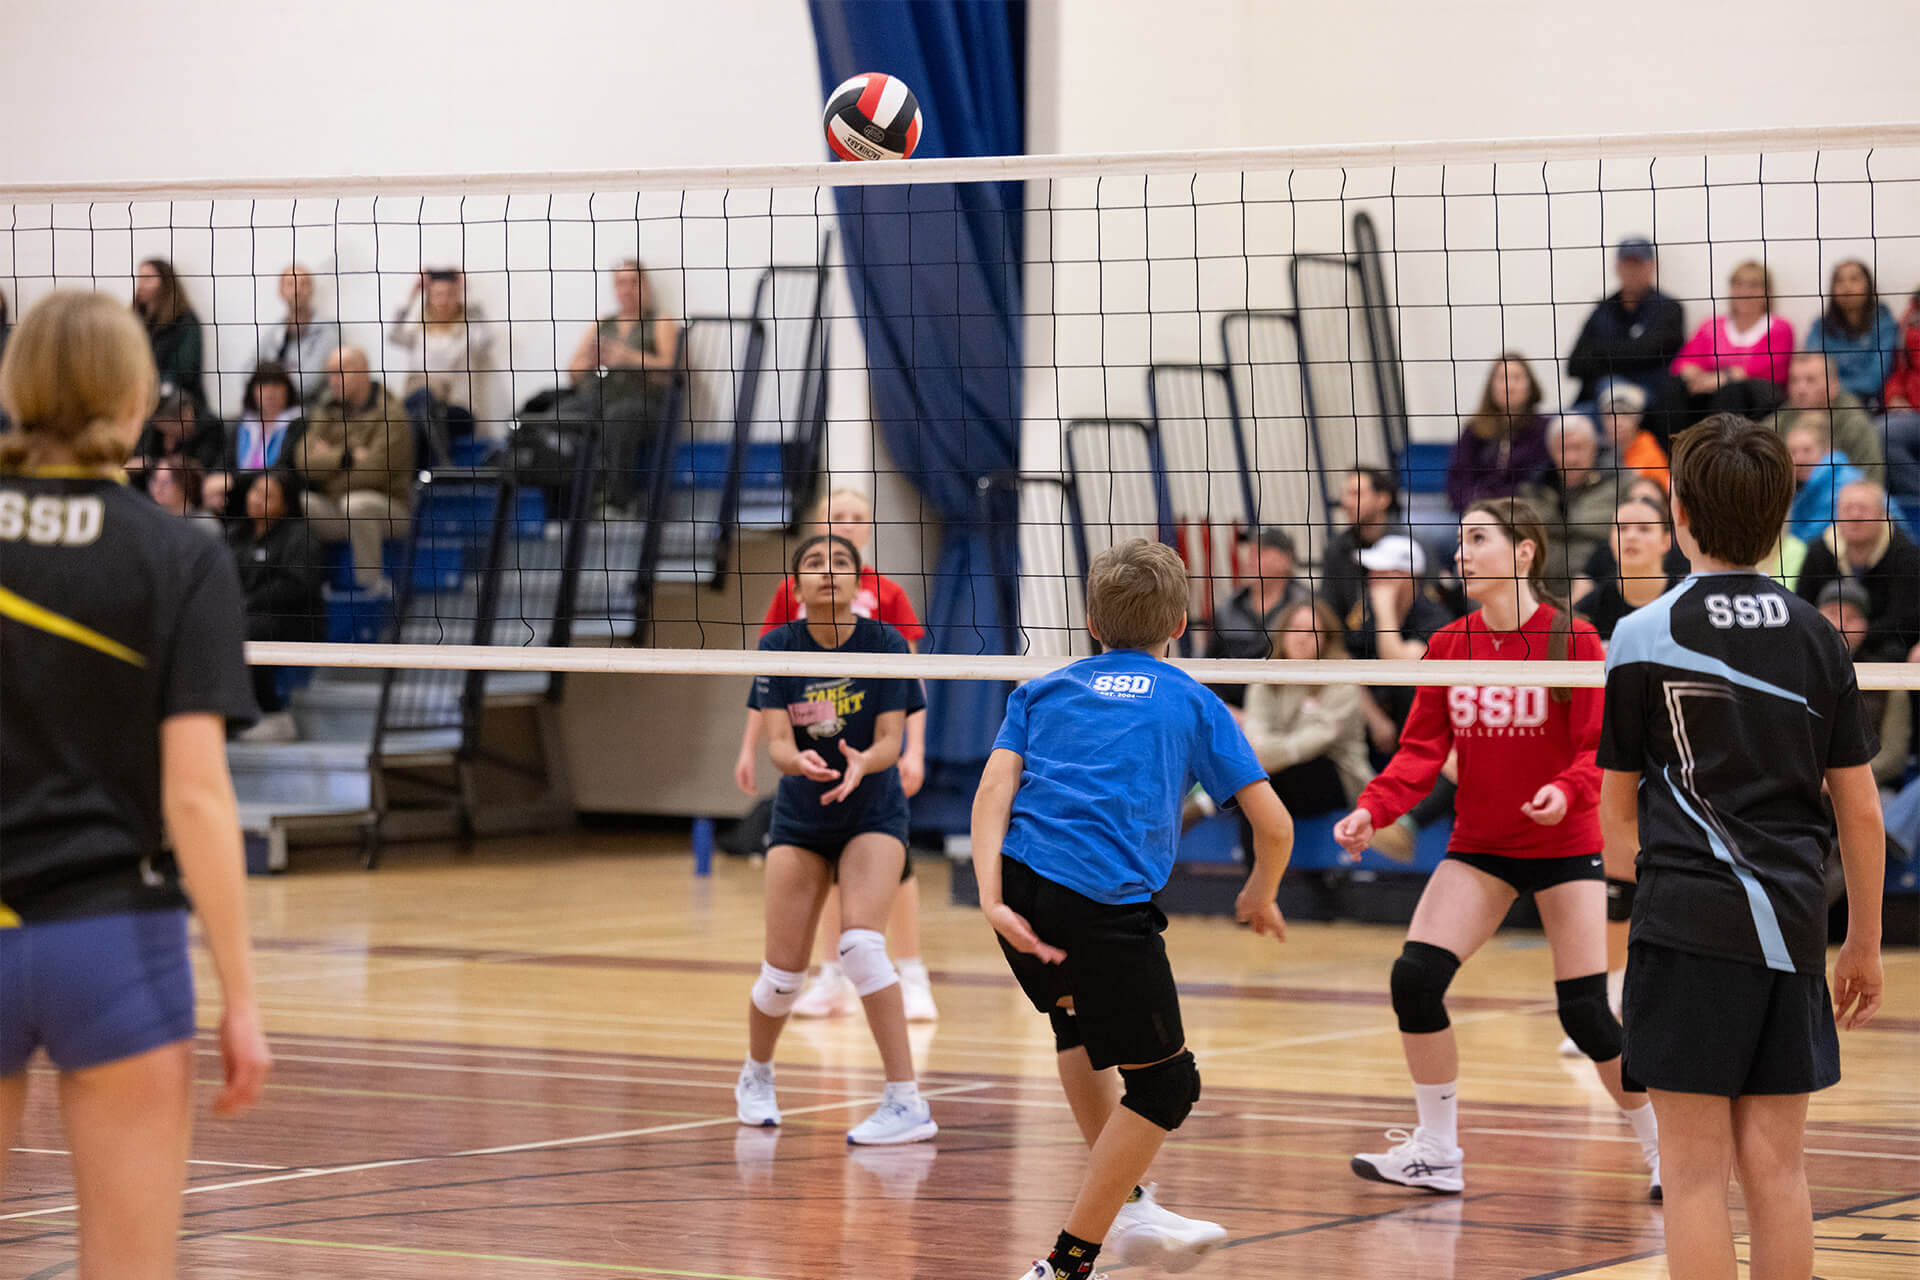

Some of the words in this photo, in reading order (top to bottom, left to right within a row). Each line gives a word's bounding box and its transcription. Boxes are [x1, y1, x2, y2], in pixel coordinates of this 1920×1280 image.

[0, 490, 104, 546] SSD
[1704, 593, 1790, 629] SSD
[1093, 676, 1151, 693] SSD
[1448, 686, 1549, 727] SSD
